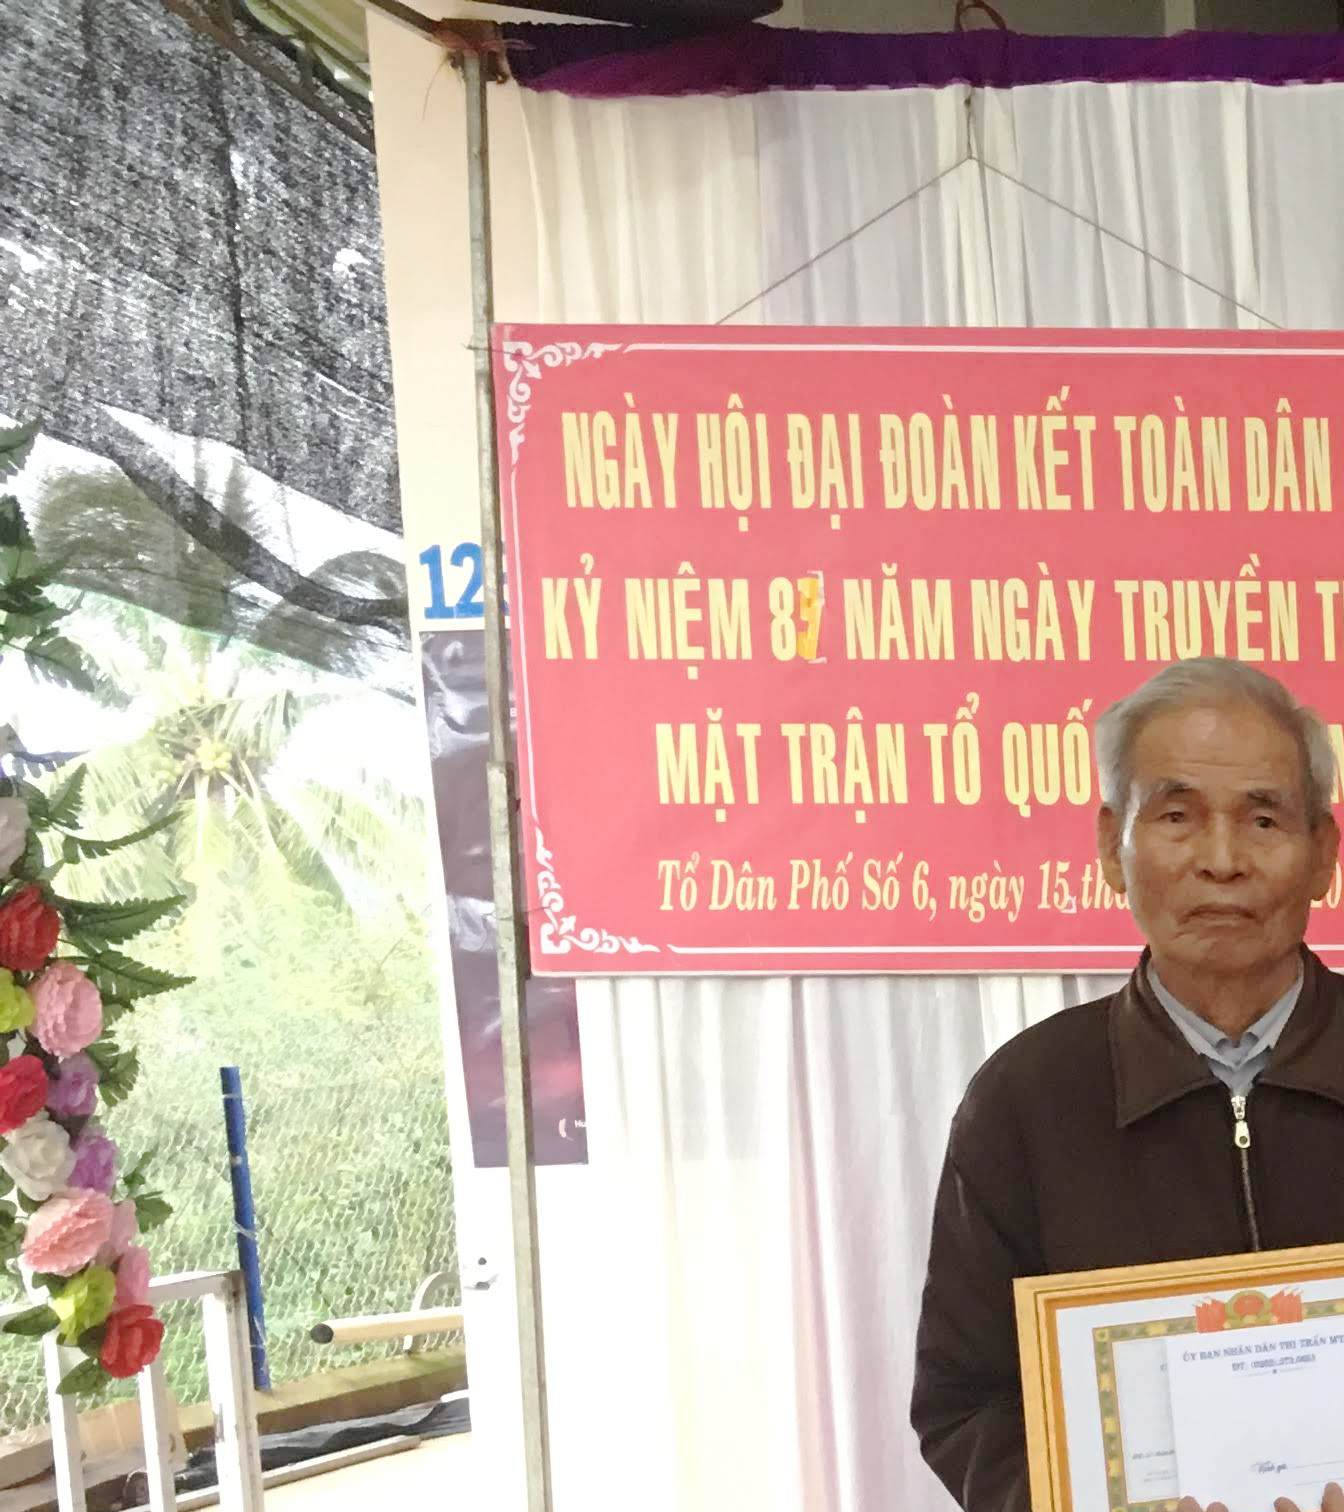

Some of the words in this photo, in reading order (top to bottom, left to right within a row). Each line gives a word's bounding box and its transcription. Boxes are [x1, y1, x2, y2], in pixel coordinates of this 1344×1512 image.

[561, 392, 678, 510] NGÀY
[696, 393, 772, 532] HỘI
[786, 412, 865, 530] ĐẠI
[879, 394, 1001, 511] ĐOÀN
[1013, 386, 1096, 511] KẾT
[1113, 396, 1231, 513] TOÀN
[1244, 397, 1333, 512] DÂN
[541, 552, 602, 660] KỶ
[624, 561, 753, 680] NIỆM
[842, 562, 956, 661] NĂM
[970, 562, 1096, 662] NGÀY
[1114, 553, 1300, 662] TRUYỀN
[655, 707, 762, 823] MẶT
[780, 706, 909, 824] TRẬN
[923, 692, 982, 806] TỔ
[1002, 699, 1096, 819] QUỐ
[657, 852, 700, 911] Tổ
[708, 858, 778, 911] Dân
[787, 852, 854, 911] Phố
[861, 852, 903, 911] Số
[911, 860, 938, 921] 6,
[948, 861, 1026, 923] ngày
